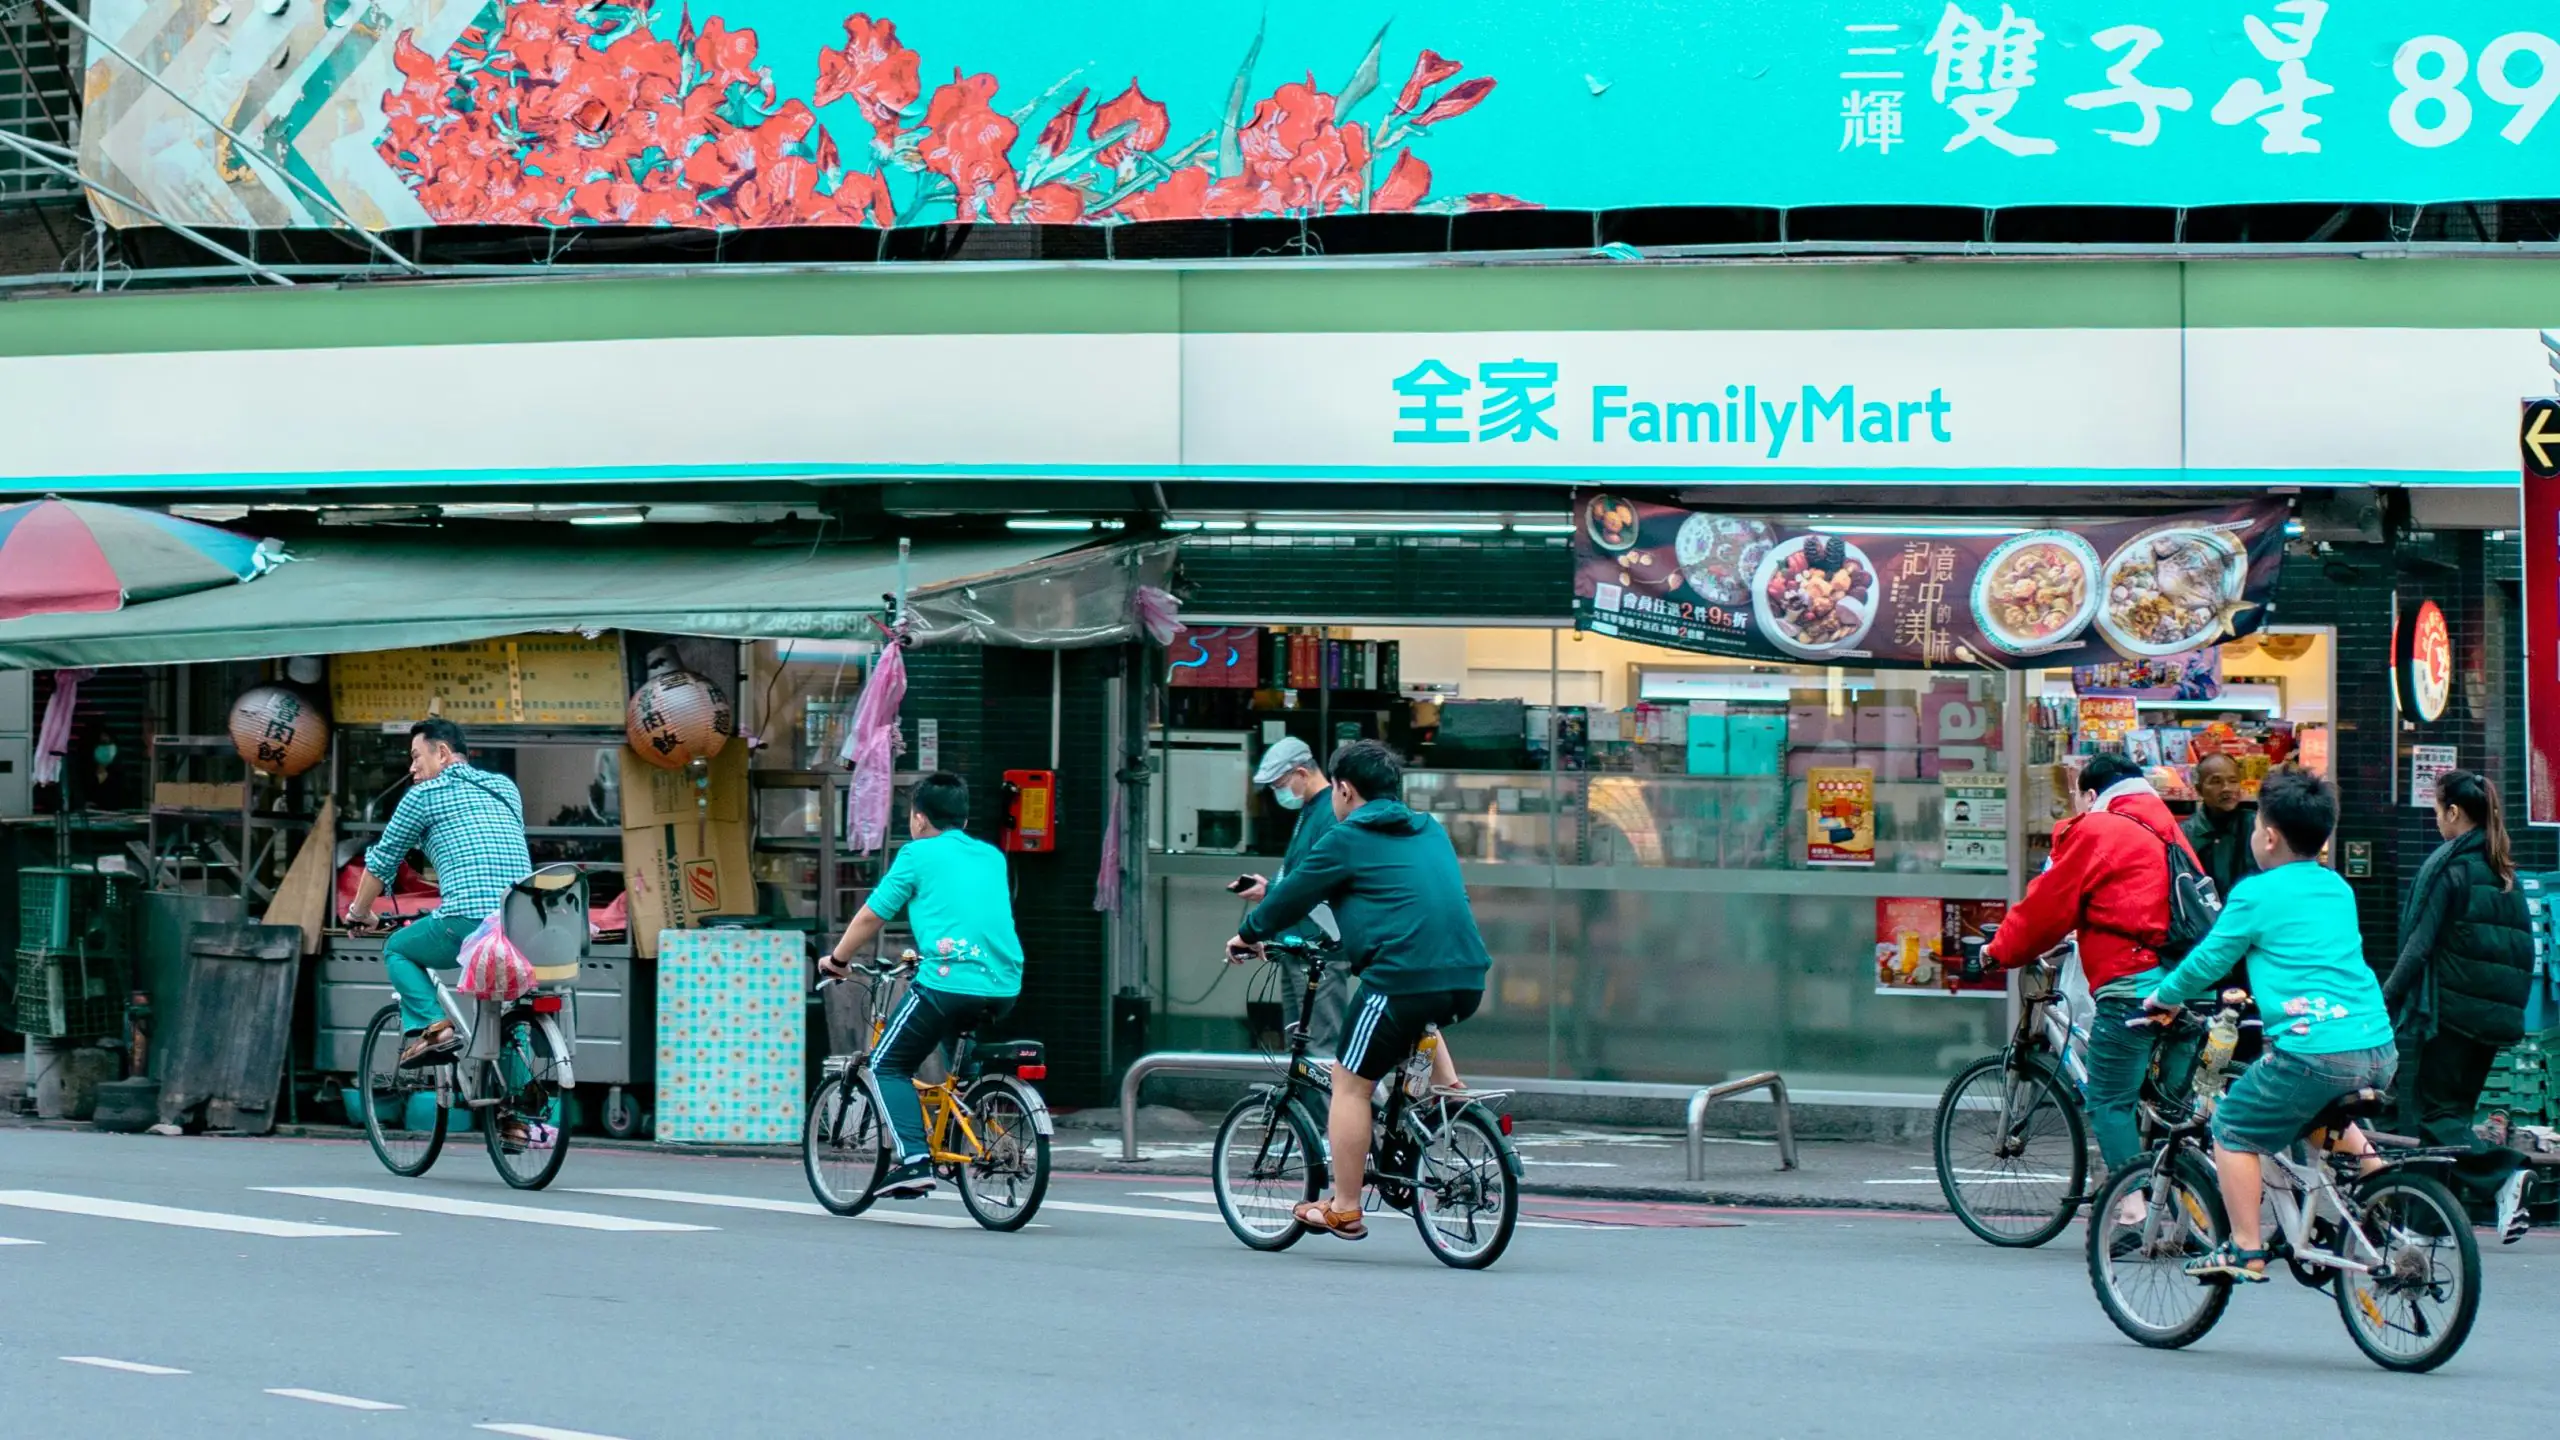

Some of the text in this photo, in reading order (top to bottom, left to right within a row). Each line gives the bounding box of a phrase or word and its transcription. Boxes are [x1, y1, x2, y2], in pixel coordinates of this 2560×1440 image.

[1839, 23, 1905, 155] 三輝
[1923, 0, 2335, 156] 雙子星
[1392, 358, 1952, 458] 全家 FamilyMart
